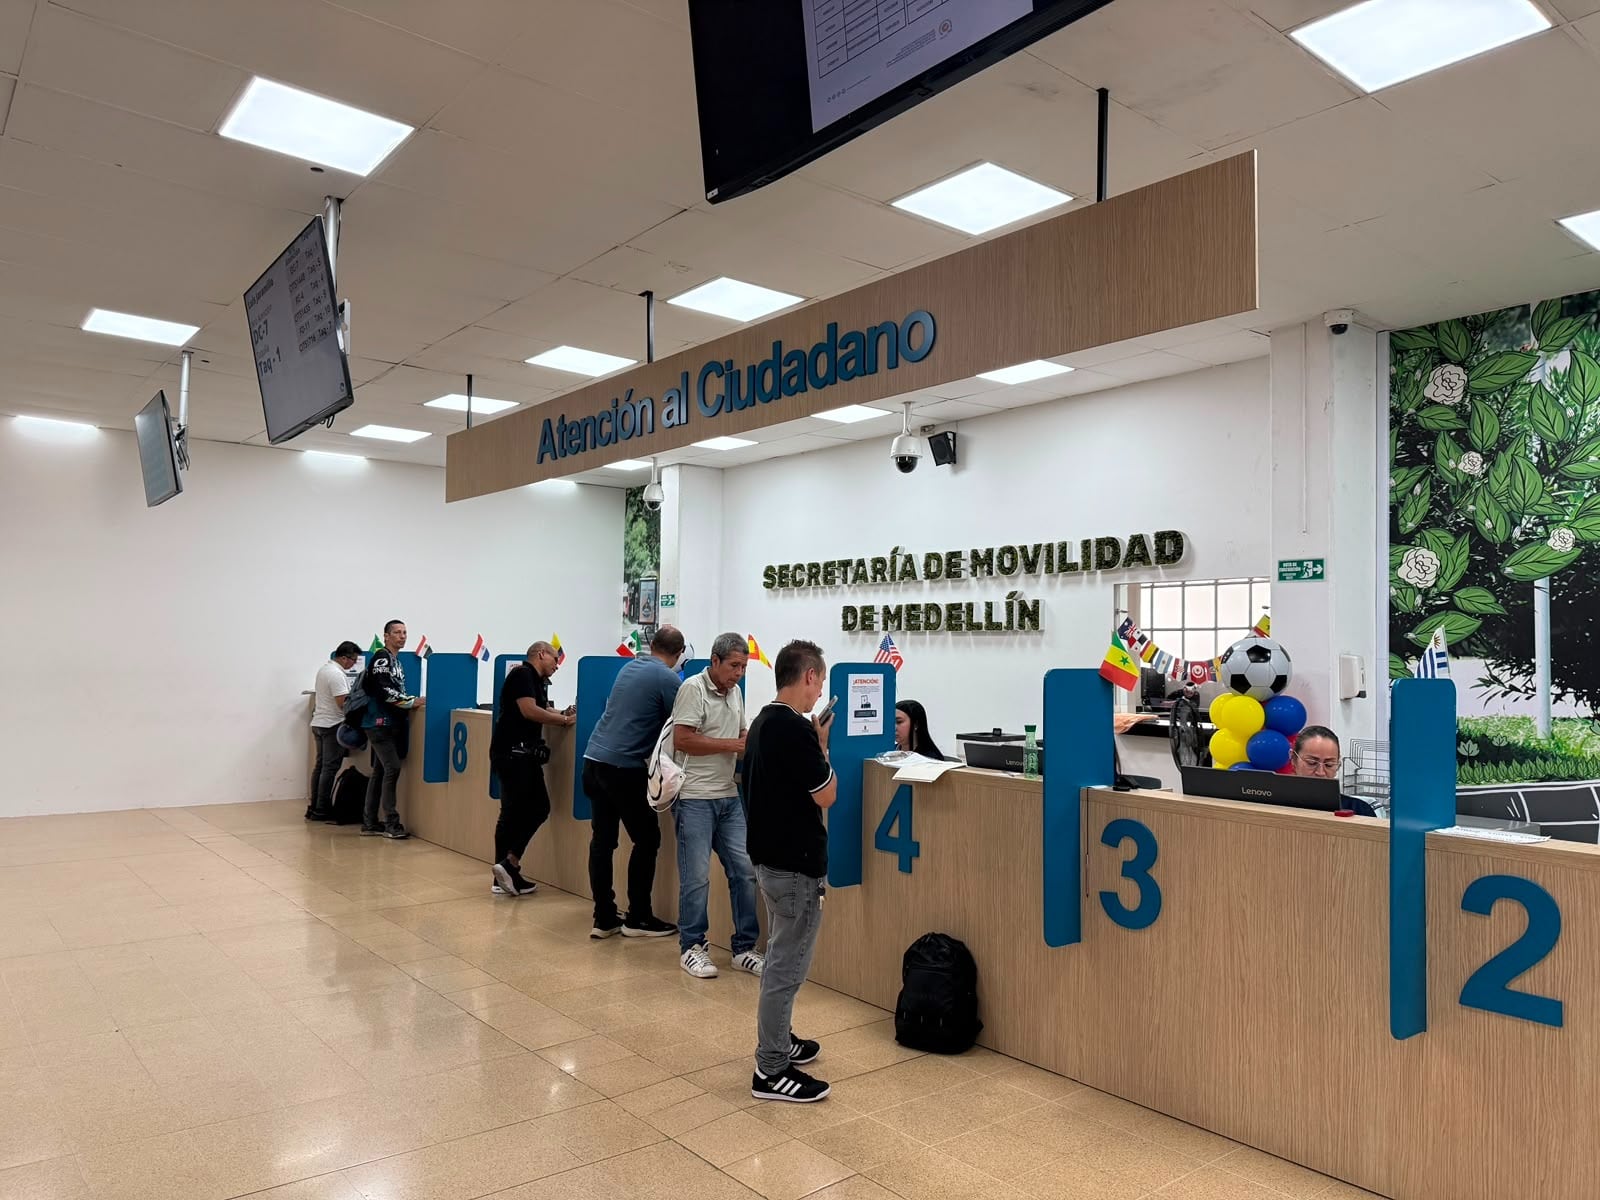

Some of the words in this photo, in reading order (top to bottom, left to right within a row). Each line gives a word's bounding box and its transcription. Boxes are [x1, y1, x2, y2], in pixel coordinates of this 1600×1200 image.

[258, 358, 273, 377] Taq
[276, 346, 282, 363] 1
[536, 388, 654, 464] Atención
[661, 371, 688, 429] al
[696, 310, 936, 417] Ciudadano
[762, 546, 920, 590] SECRETARÍA
[923, 550, 967, 580] DE
[969, 530, 1185, 577] MOVILIDAD
[841, 604, 876, 632] DE
[881, 591, 1042, 632] MEDELLÍN
[453, 722, 467, 773] 8
[1005, 759, 1025, 767] Lenov
[1241, 786, 1272, 797] Lenovo
[875, 784, 920, 874] 4
[1100, 818, 1162, 929] 3
[1459, 874, 1563, 1027] 2
